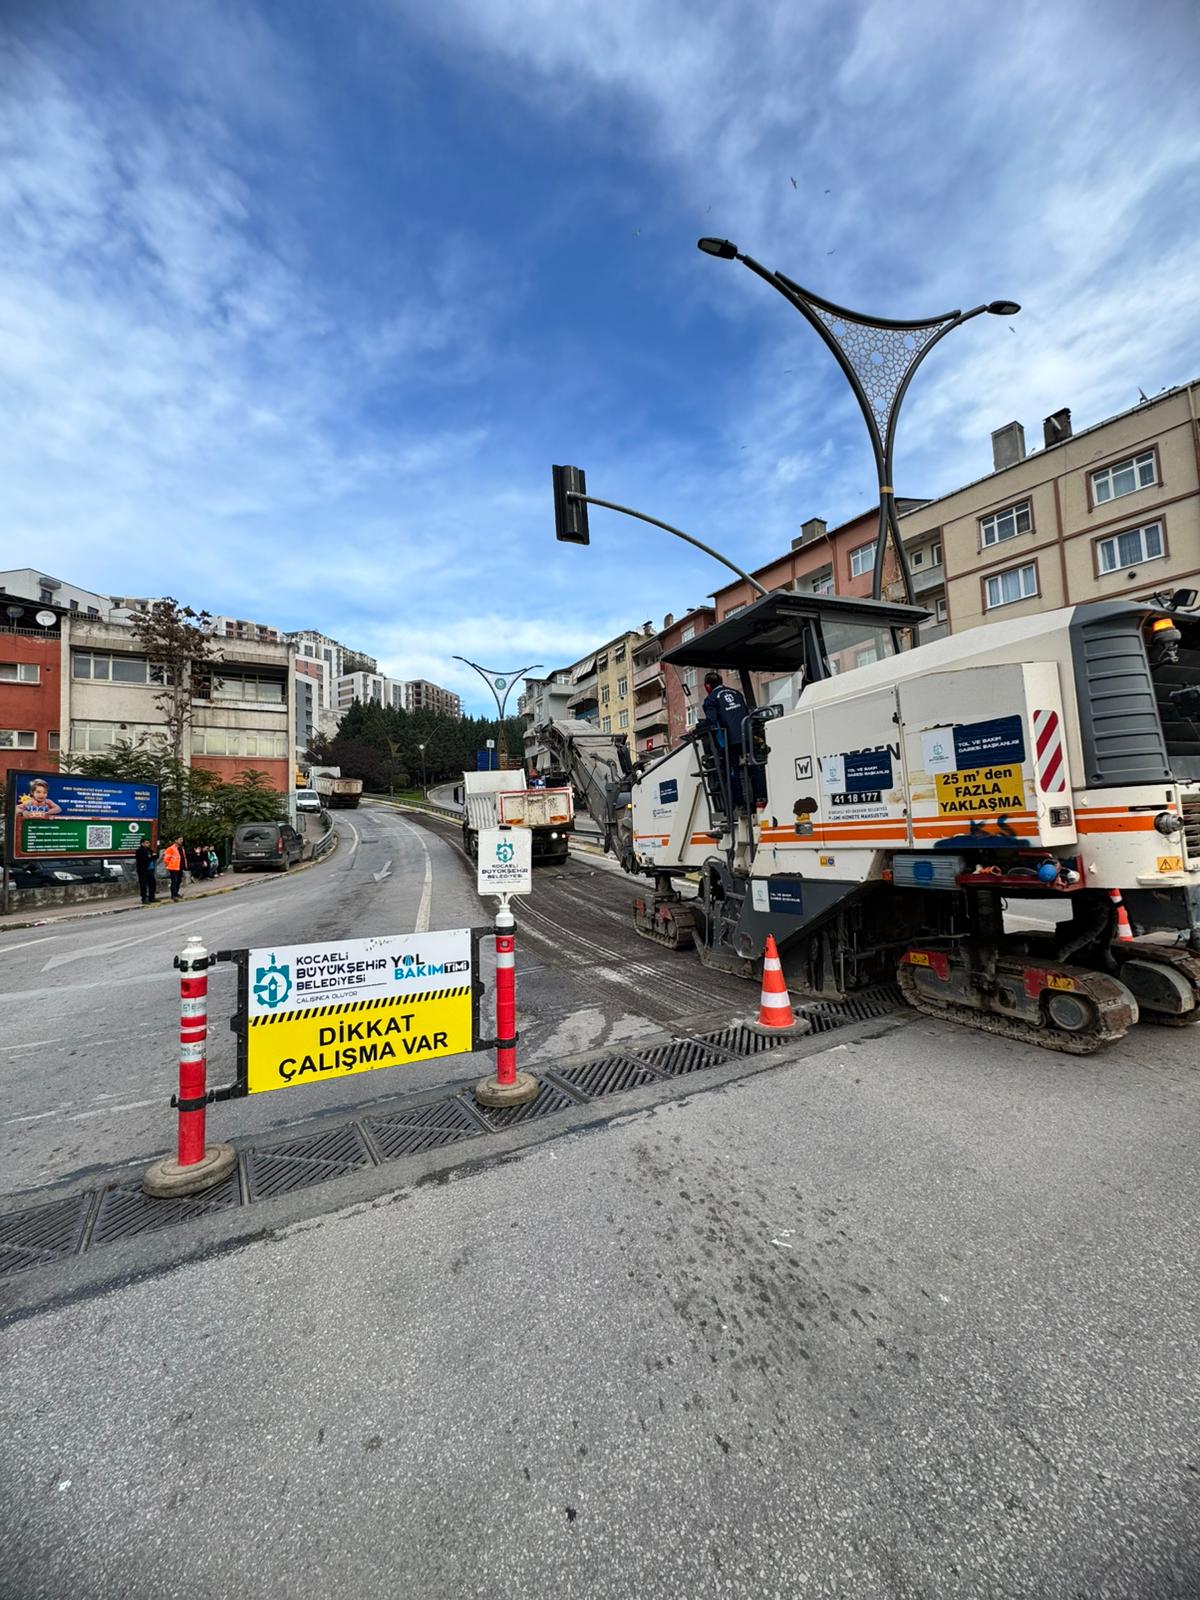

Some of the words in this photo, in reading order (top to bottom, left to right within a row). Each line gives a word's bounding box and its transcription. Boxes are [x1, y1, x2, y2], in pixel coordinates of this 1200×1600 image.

[943, 773, 959, 786] 25
[985, 768, 1012, 780] den
[834, 795, 845, 804] 41
[847, 794, 858, 803] 18
[861, 792, 878, 802] 177
[955, 783, 1002, 798] FAZLA
[941, 795, 1023, 812] YAKLAŞMA
[296, 952, 349, 966] KOCAELİ
[391, 953, 425, 968] YOL
[296, 958, 387, 979] BÜYÜKŞEHİR
[394, 964, 445, 981] BAKIM
[331, 990, 358, 1000] OLUYOR
[319, 1014, 415, 1047] DİKKAT
[278, 1041, 397, 1082] ÇALIŞMA
[402, 1031, 449, 1055] VAR
